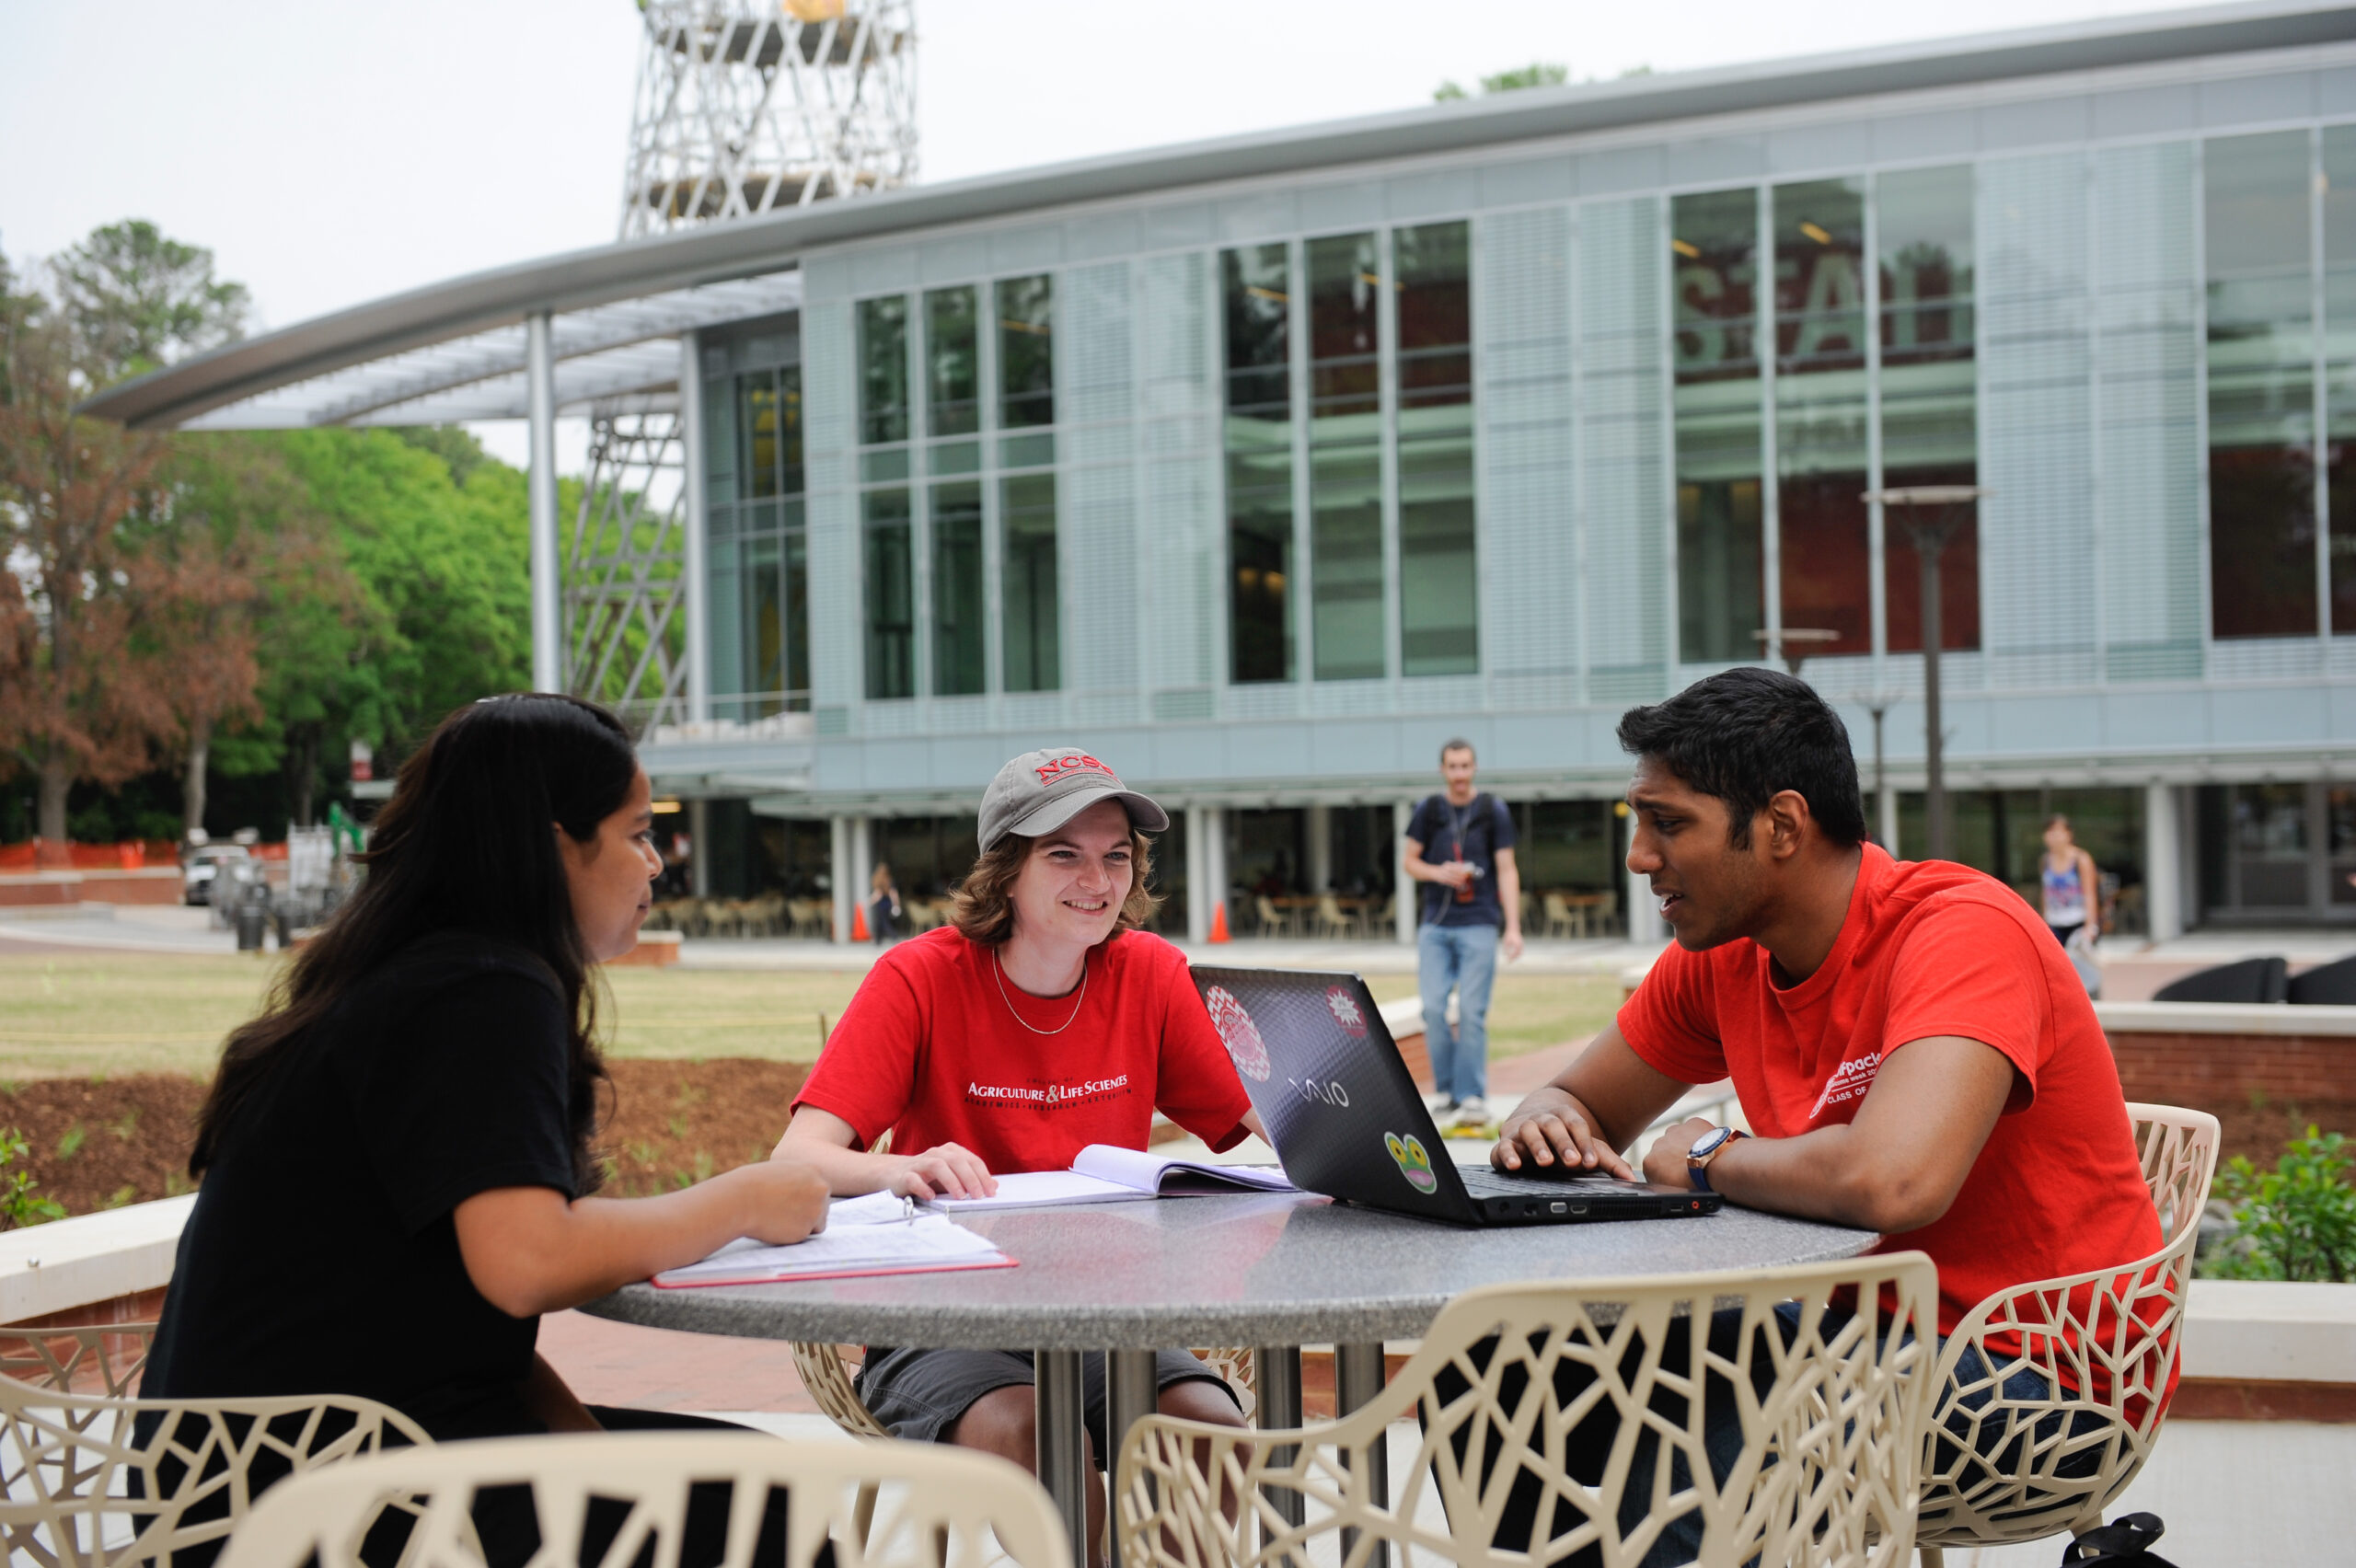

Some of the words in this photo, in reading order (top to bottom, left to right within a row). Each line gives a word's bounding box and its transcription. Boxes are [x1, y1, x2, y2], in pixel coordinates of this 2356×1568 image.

[968, 1081, 1045, 1101] AGRICULTURE
[1045, 1084, 1060, 1104] &
[1060, 1085, 1084, 1100] LIFE
[1084, 1074, 1127, 1095] SCIENCES
[1827, 1090, 1852, 1104] CLASS
[1854, 1086, 1867, 1096] OF
